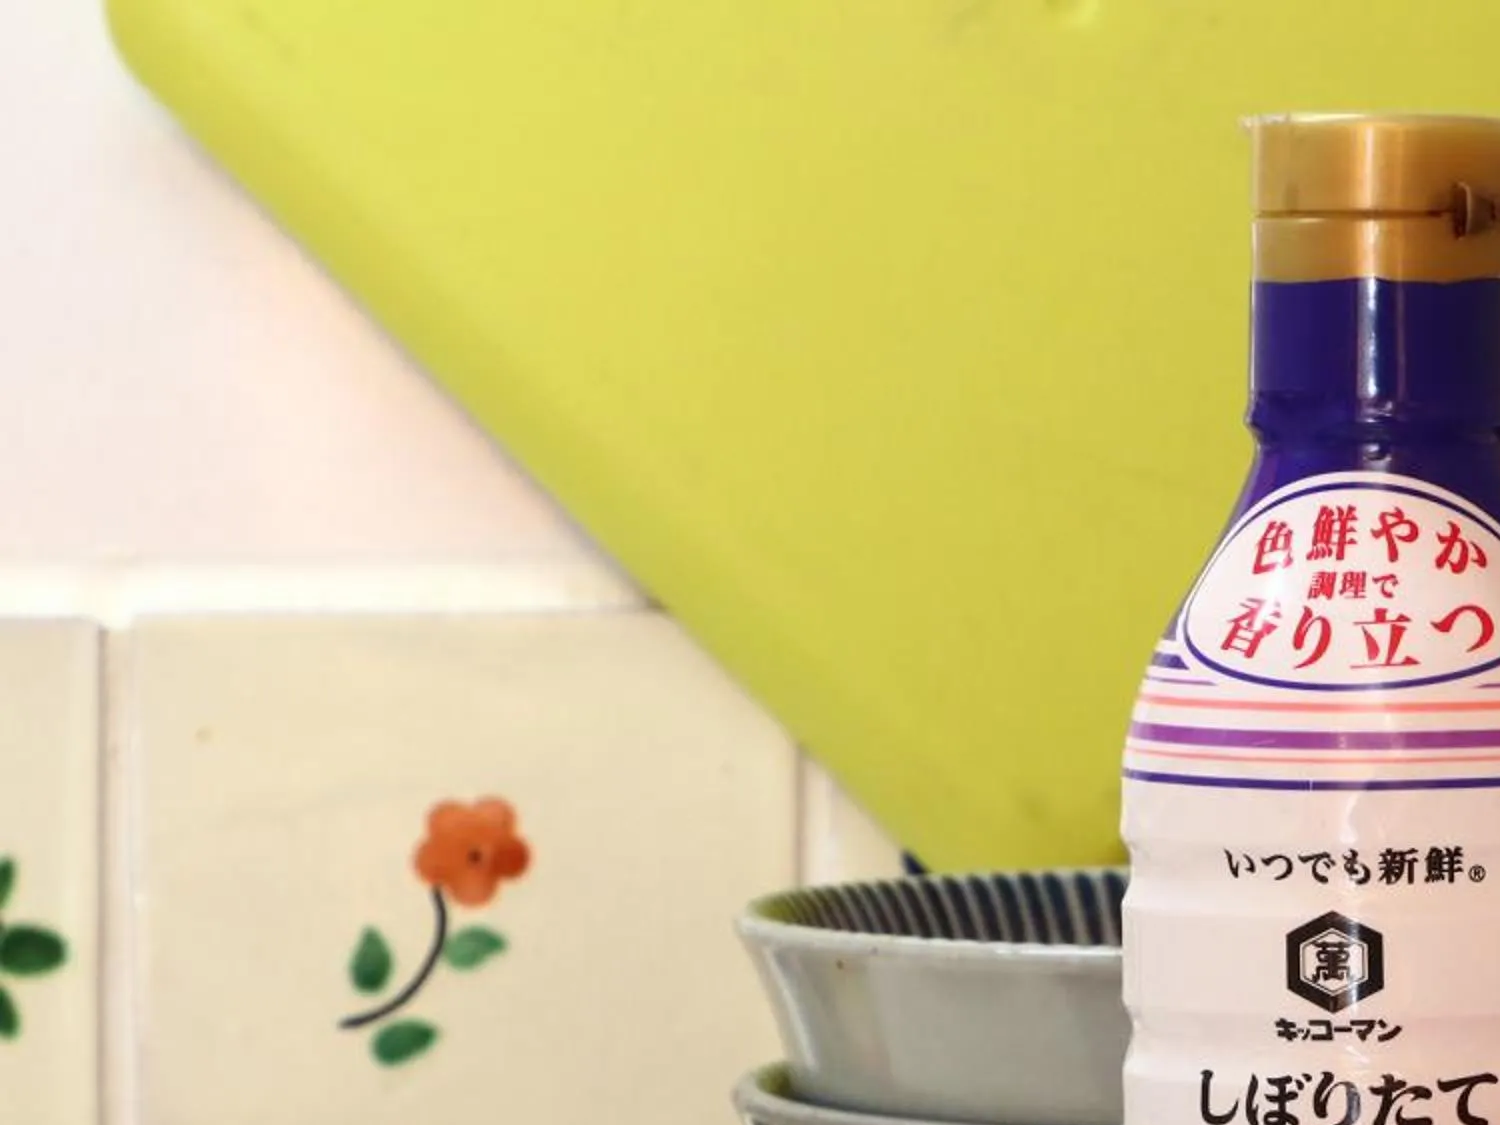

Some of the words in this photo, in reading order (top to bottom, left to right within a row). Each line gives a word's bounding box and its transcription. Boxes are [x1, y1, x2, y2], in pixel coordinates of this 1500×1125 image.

[1252, 505, 1488, 575] 色鮮やか
[1308, 570, 1399, 600] 調理で
[1219, 597, 1496, 670] 香り立つ
[1275, 1018, 1402, 1042] キッコーマン
